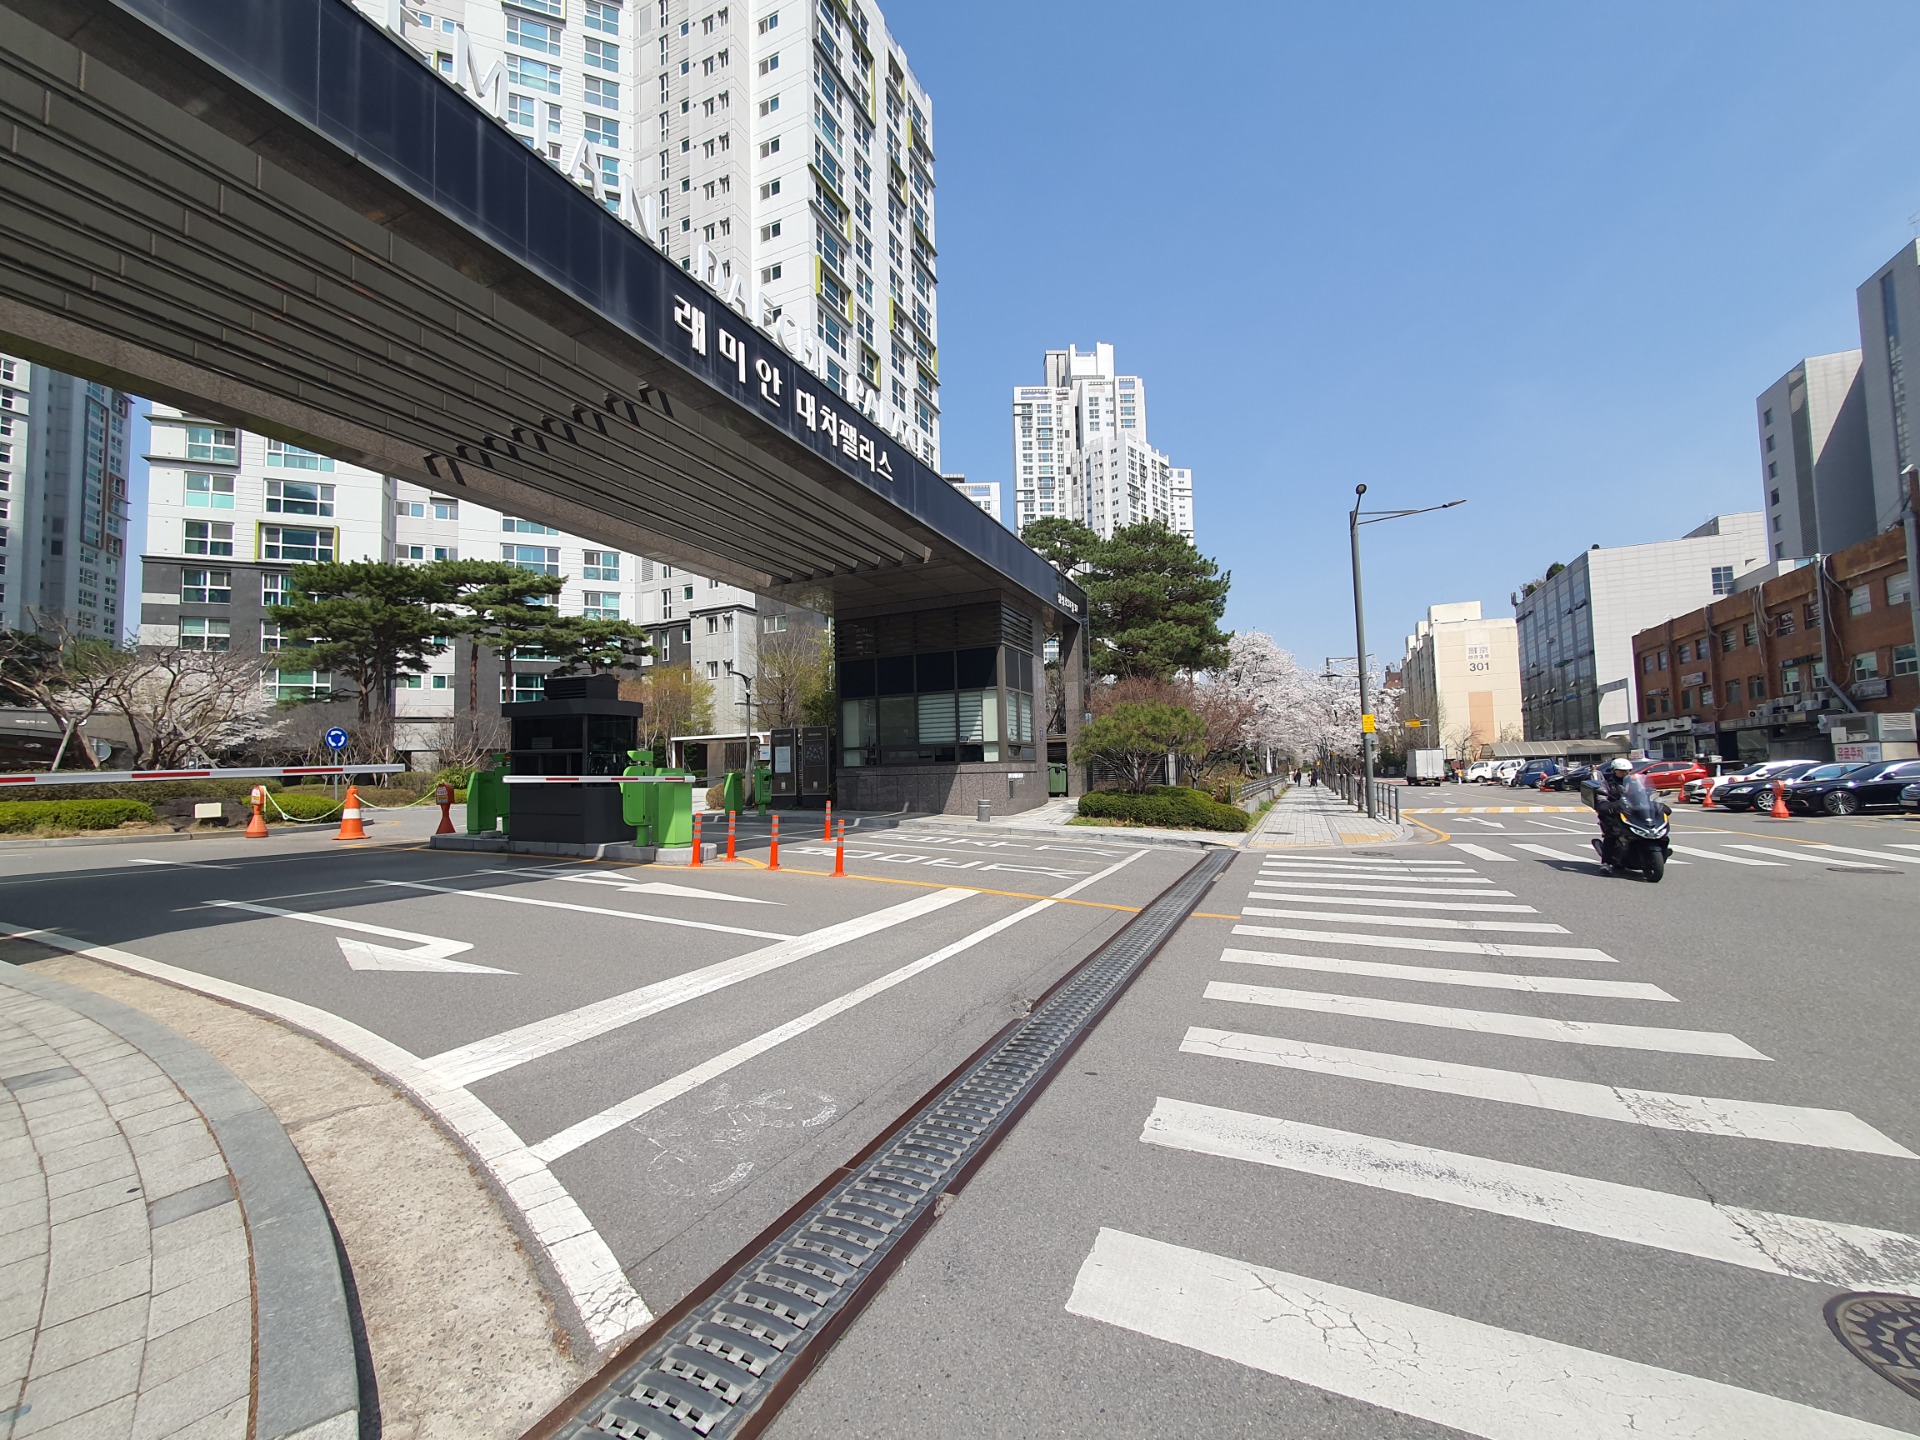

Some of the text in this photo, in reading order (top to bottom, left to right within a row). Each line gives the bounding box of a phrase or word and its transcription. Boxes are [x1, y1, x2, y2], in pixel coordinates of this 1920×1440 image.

[674, 294, 894, 482] 래미안 대치팰리스
[698, 243, 828, 382] DAECHI
[847, 374, 931, 463] PALACE
[1469, 662, 1489, 672] 301
